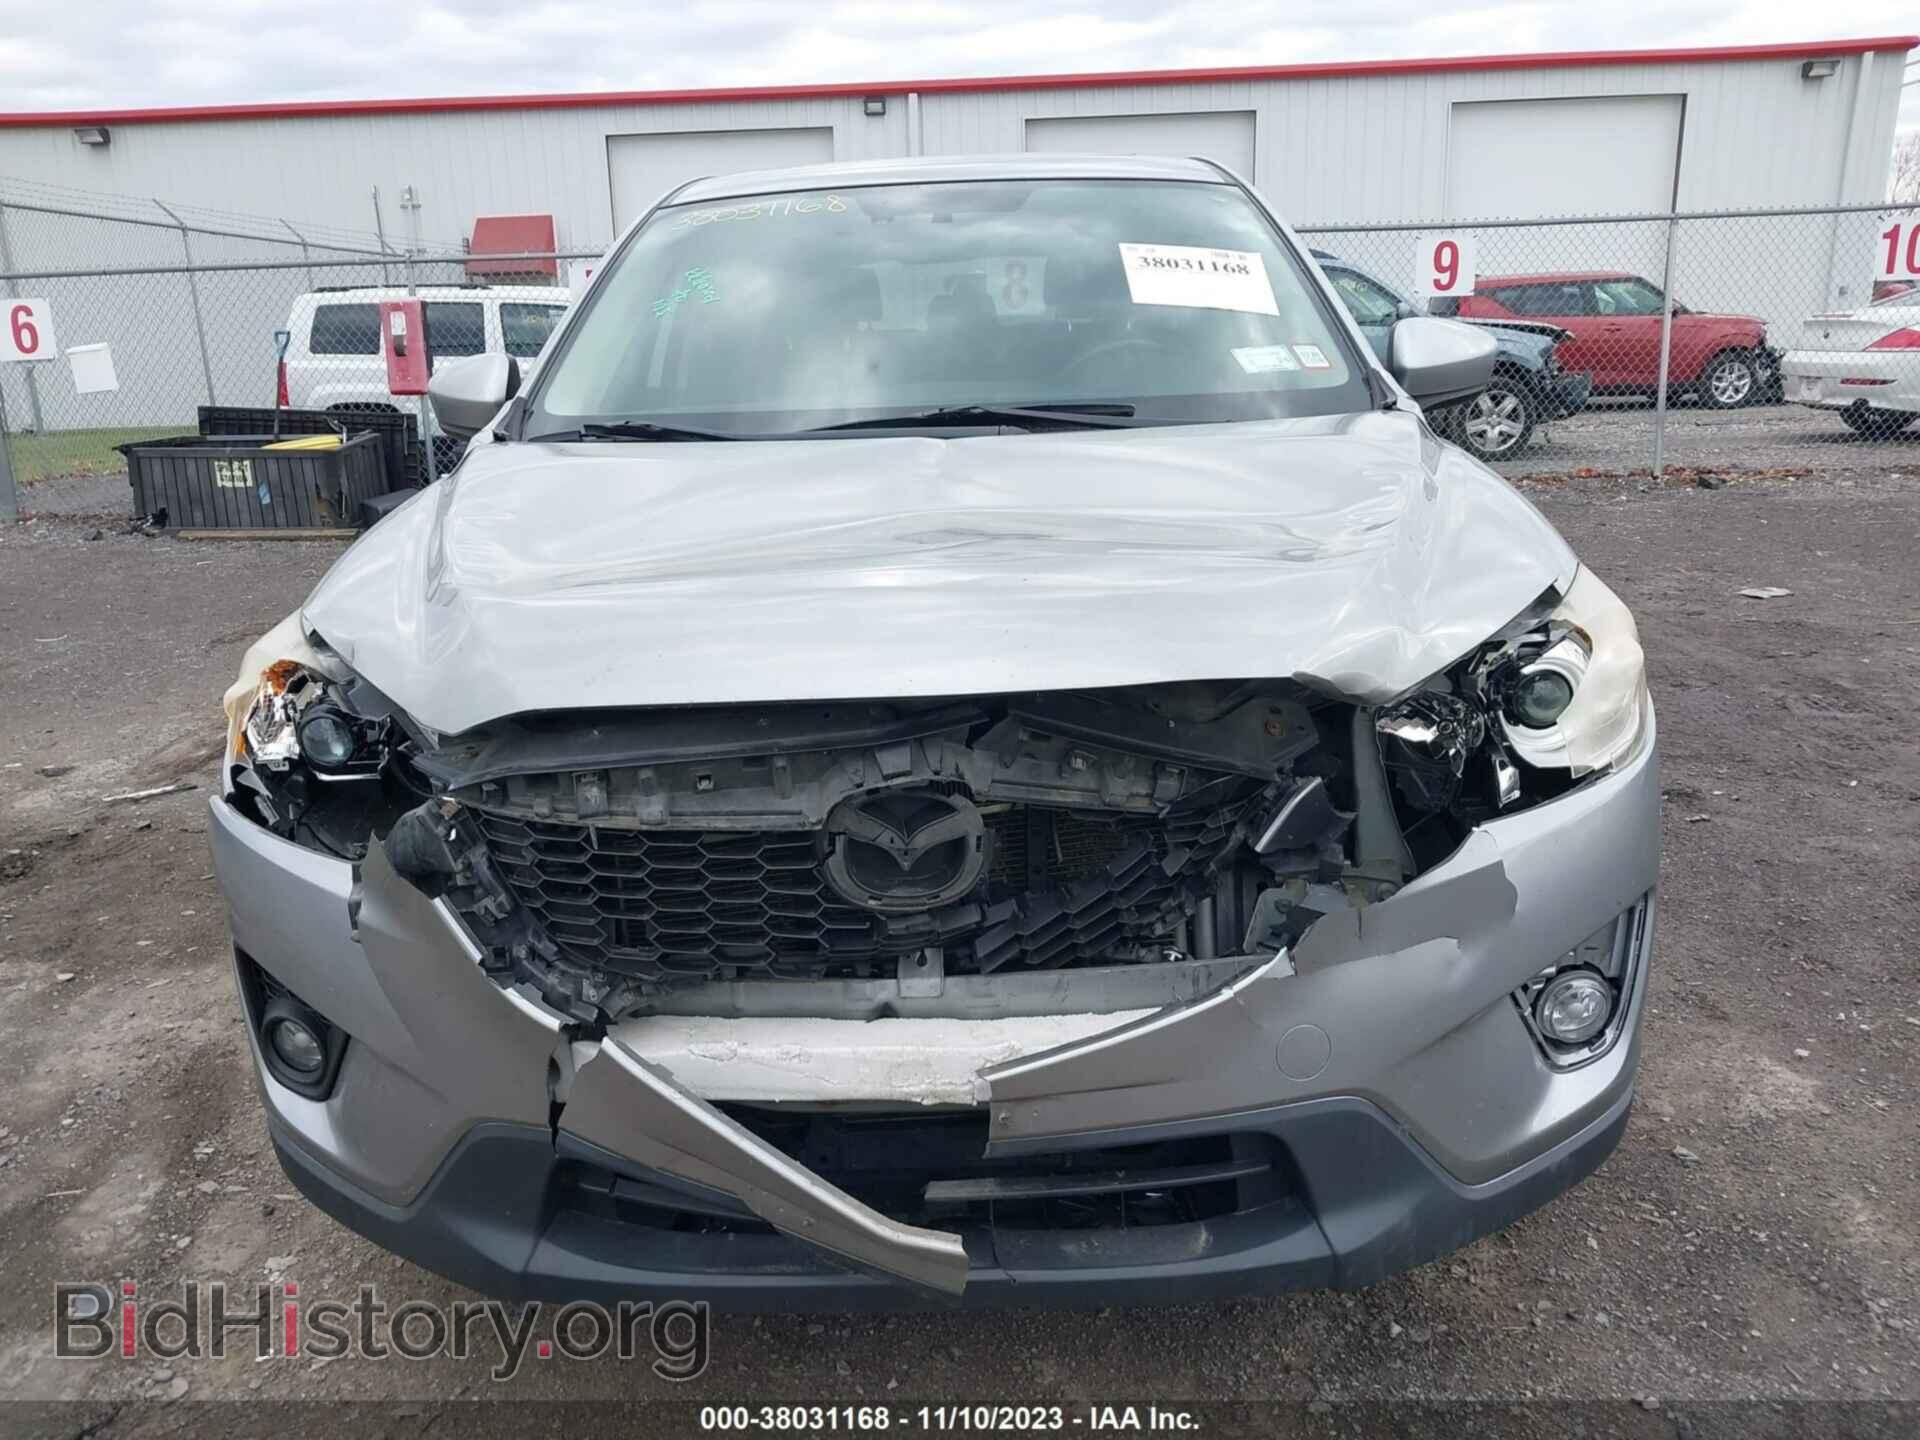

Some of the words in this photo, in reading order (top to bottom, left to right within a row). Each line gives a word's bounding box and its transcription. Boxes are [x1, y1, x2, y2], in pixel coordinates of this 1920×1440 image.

[1137, 255, 1251, 276] 38031168
[1433, 240, 1459, 291] 9
[10, 304, 39, 354] 6
